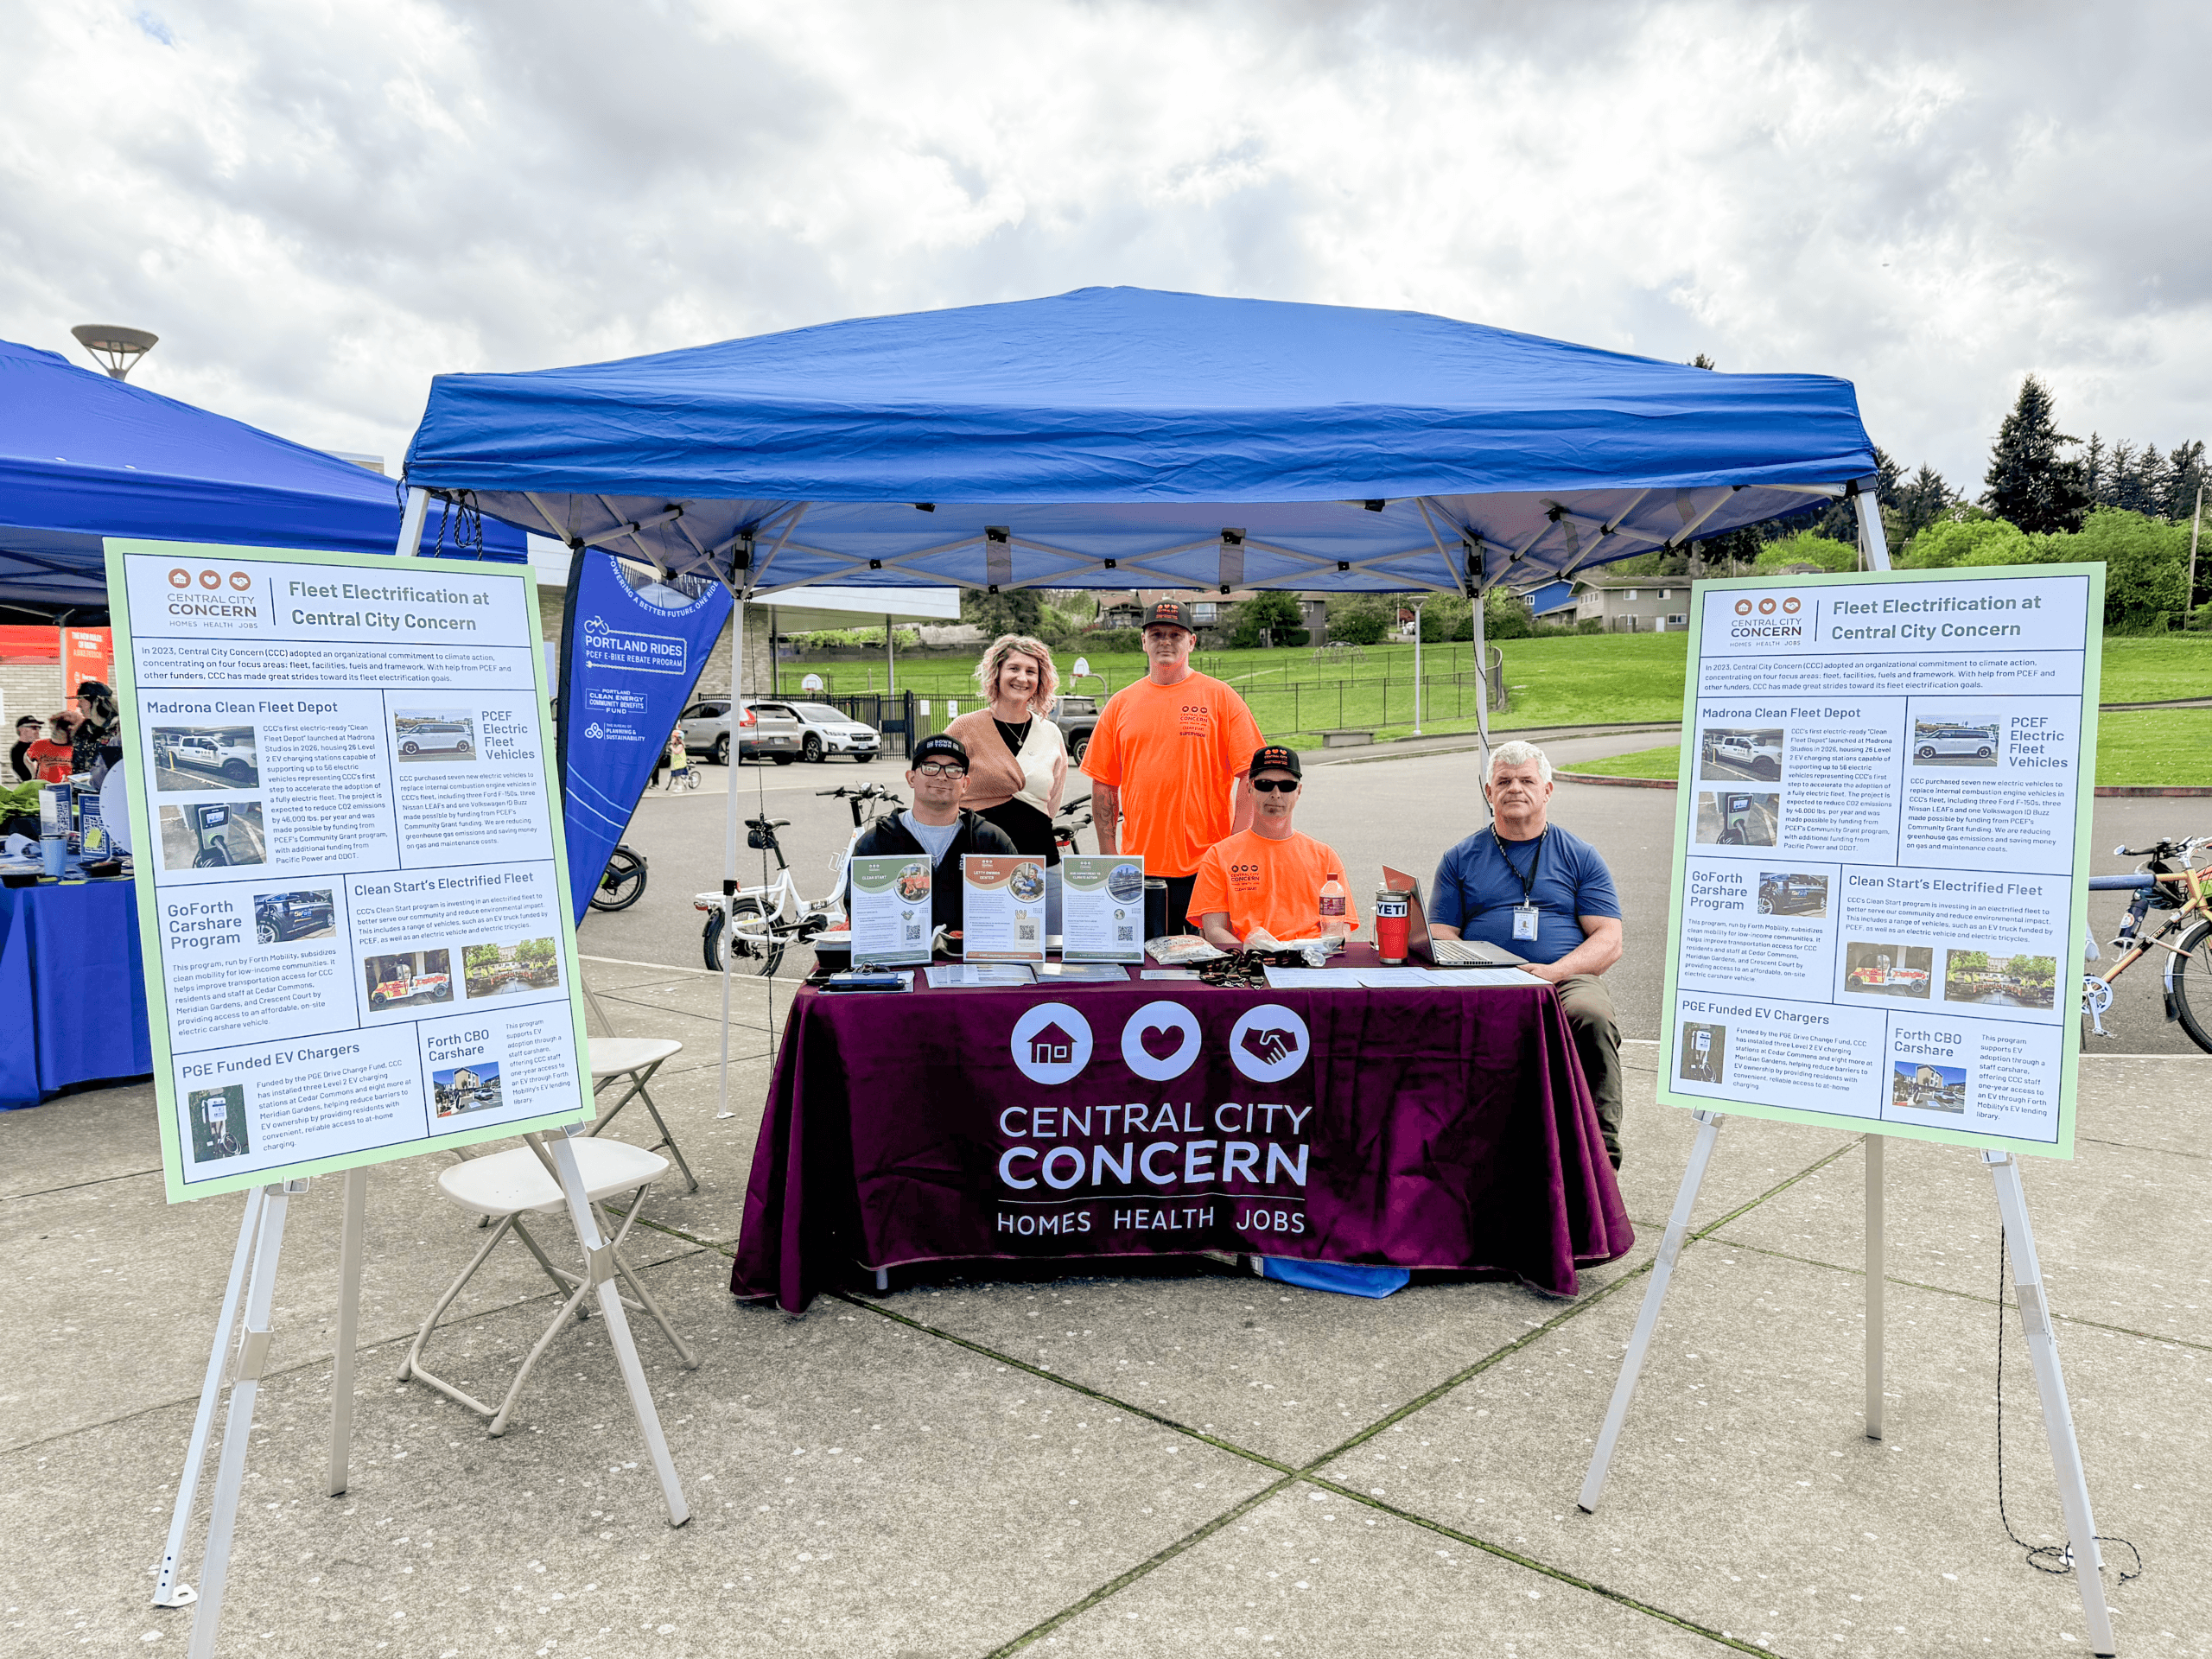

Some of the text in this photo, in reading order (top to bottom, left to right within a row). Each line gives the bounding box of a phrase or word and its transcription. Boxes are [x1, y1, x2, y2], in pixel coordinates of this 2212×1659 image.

[289, 581, 489, 605] Fleet Electrification at
[609, 555, 634, 598] POWERING
[639, 600, 666, 617] BETTER
[667, 606, 696, 618] FUTURE,
[695, 596, 709, 609] ONE
[706, 581, 719, 599] RIDE
[167, 593, 254, 604] CENTRAL CITY
[1833, 595, 2041, 615] Fleet Electrification at
[168, 603, 256, 617] CONCERN
[291, 609, 476, 631] Central City Concern
[1731, 617, 1801, 627] CENTRAL CITY
[1730, 625, 1801, 637] CONCERN
[1832, 623, 2020, 641] Central City Concern
[151, 646, 176, 655] 2023,
[211, 648, 227, 657] City
[264, 648, 288, 657] (CCC)
[289, 650, 321, 658] adopted
[334, 651, 386, 659] organizational
[585, 635, 682, 656] PORTLAND RIDES
[585, 650, 682, 667] PCEF E-BIKE REBATE PROGRAM
[147, 701, 337, 715] Madrona Clean Fleet Depot
[481, 710, 512, 721] PCEF
[1702, 707, 1860, 719] Madrona Clean Fleet Depot
[483, 723, 527, 734] Electric
[2011, 717, 2048, 727] PCEF
[484, 736, 514, 747] Fleet
[2010, 730, 2064, 740] Electric
[485, 748, 534, 759] Vehicles
[2009, 743, 2044, 754] Fleet
[2009, 756, 2067, 767] Vehicles
[354, 872, 533, 895] Clean Start's Electrified Fleet
[1692, 870, 1742, 885] GoForth
[1849, 875, 2042, 895] Clean Start's Electrified Fleet
[1691, 883, 1747, 896] Carshare
[167, 900, 233, 917] GoForth
[1377, 903, 1405, 915] YETI
[1690, 896, 1744, 910] Program
[169, 917, 241, 932] Carshare
[170, 933, 240, 949] Program
[1682, 1000, 1829, 1025] PGE Funded EV Chargers
[427, 1029, 489, 1048] Forth CBO
[1895, 1028, 1961, 1044] Forth CBO
[428, 1045, 484, 1061] Carshare
[1894, 1041, 1953, 1056] Carshare
[182, 1044, 359, 1078] PGE Funded EV Chargers
[999, 1102, 1312, 1137] CENTRAL CITY
[998, 1140, 1308, 1189] CONCERN
[997, 1207, 1304, 1235] HOMES HEALTH JOBS
